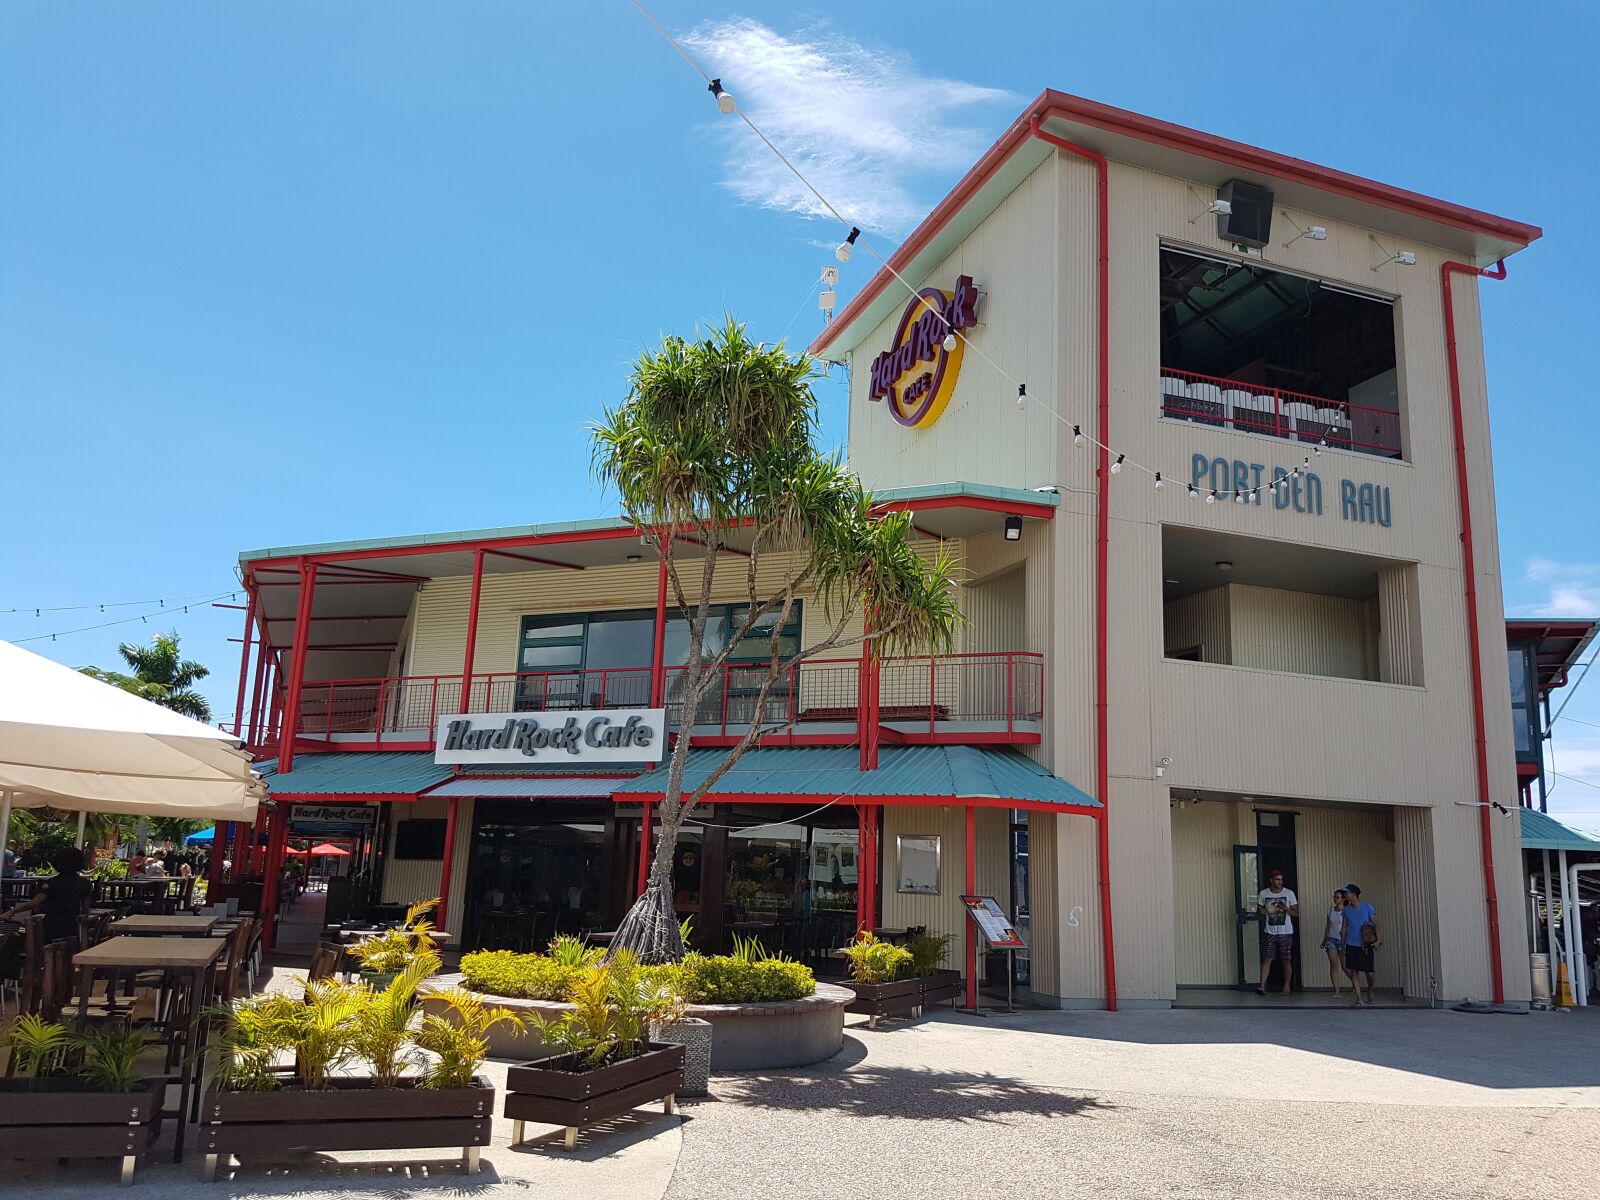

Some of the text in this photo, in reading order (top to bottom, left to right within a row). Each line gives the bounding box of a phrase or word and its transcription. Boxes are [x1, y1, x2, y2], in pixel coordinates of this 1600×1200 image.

[869, 274, 978, 402] Hard Rock
[902, 372, 932, 404] CAFE
[1192, 453, 1265, 506] PORT
[1342, 479, 1391, 527] RAU
[444, 715, 653, 756] Hard Rock Cafe
[293, 807, 371, 820] Hard Rock Cafe
